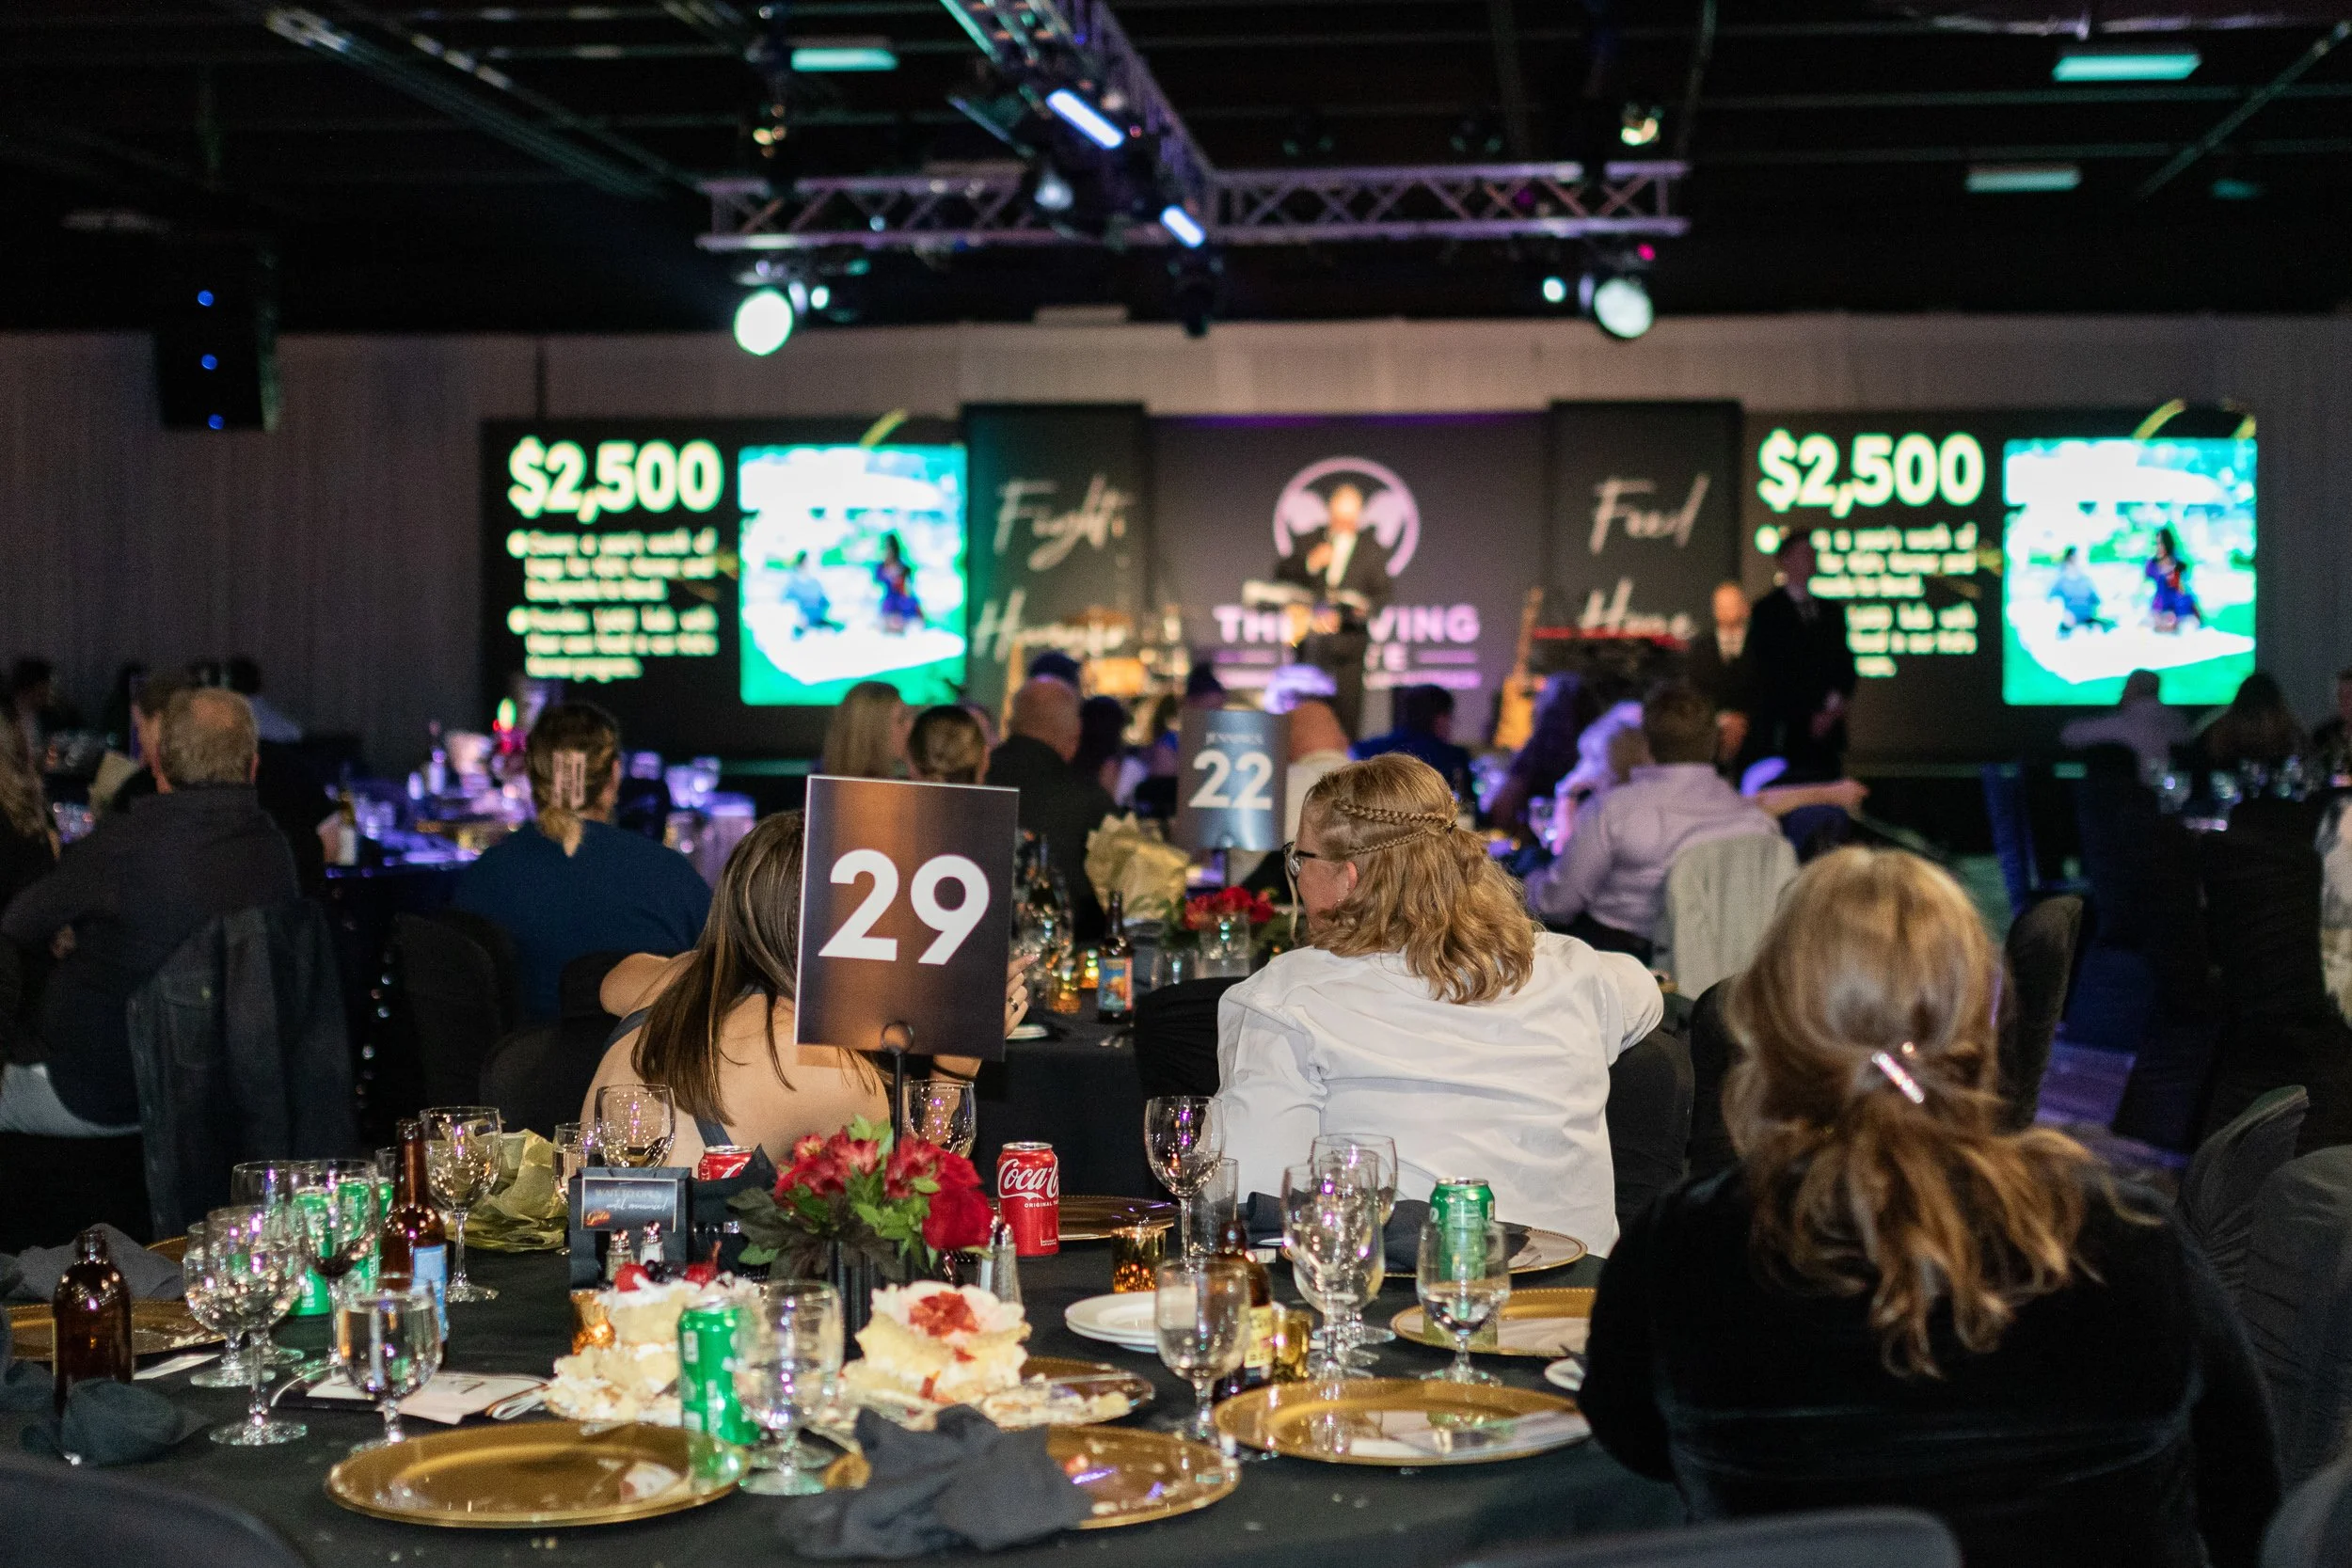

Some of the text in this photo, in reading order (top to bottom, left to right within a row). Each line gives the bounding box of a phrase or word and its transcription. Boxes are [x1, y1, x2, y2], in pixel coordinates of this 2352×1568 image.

[508, 436, 723, 524] $2,500
[1757, 428, 1985, 518] $2,500
[1189, 750, 1274, 811] 22
[818, 848, 990, 966] 29
